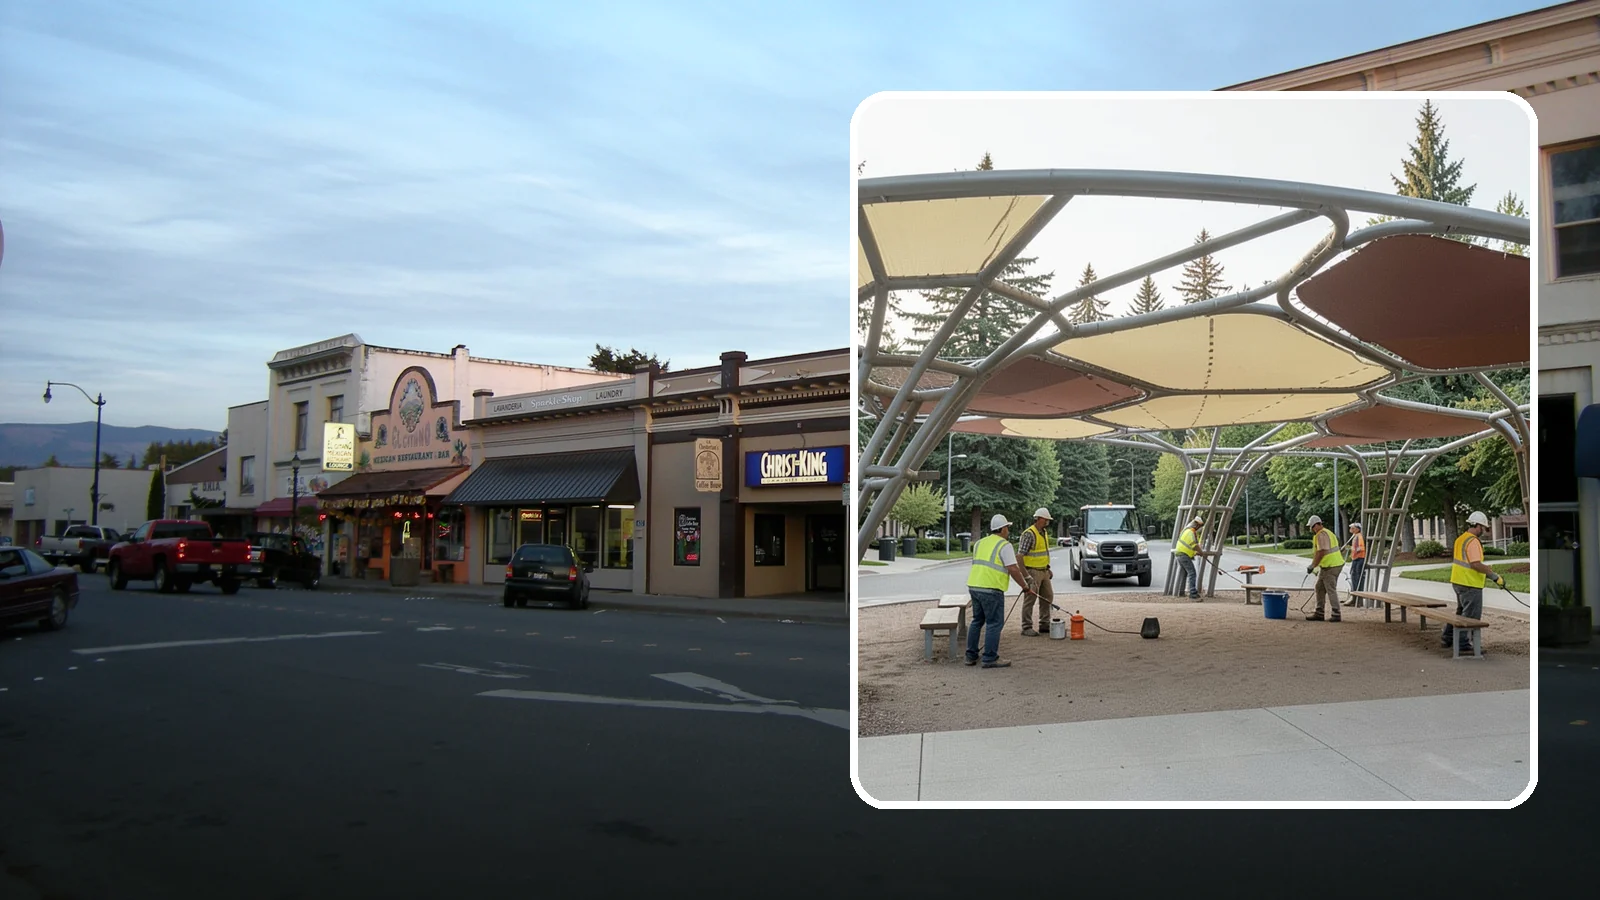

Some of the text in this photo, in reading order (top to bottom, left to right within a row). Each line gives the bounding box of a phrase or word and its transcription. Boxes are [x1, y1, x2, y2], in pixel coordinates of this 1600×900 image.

[561, 394, 582, 405] Shop
[595, 389, 623, 400] LAUNDRY
[493, 402, 522, 413] LAVANDERIA
[373, 454, 396, 464] MEXICAN
[397, 452, 433, 462] RESTAURANT
[438, 450, 450, 459] BAR
[761, 452, 797, 478] CHRIST
[799, 450, 827, 477] KING
[696, 480, 722, 489] Coffee House
